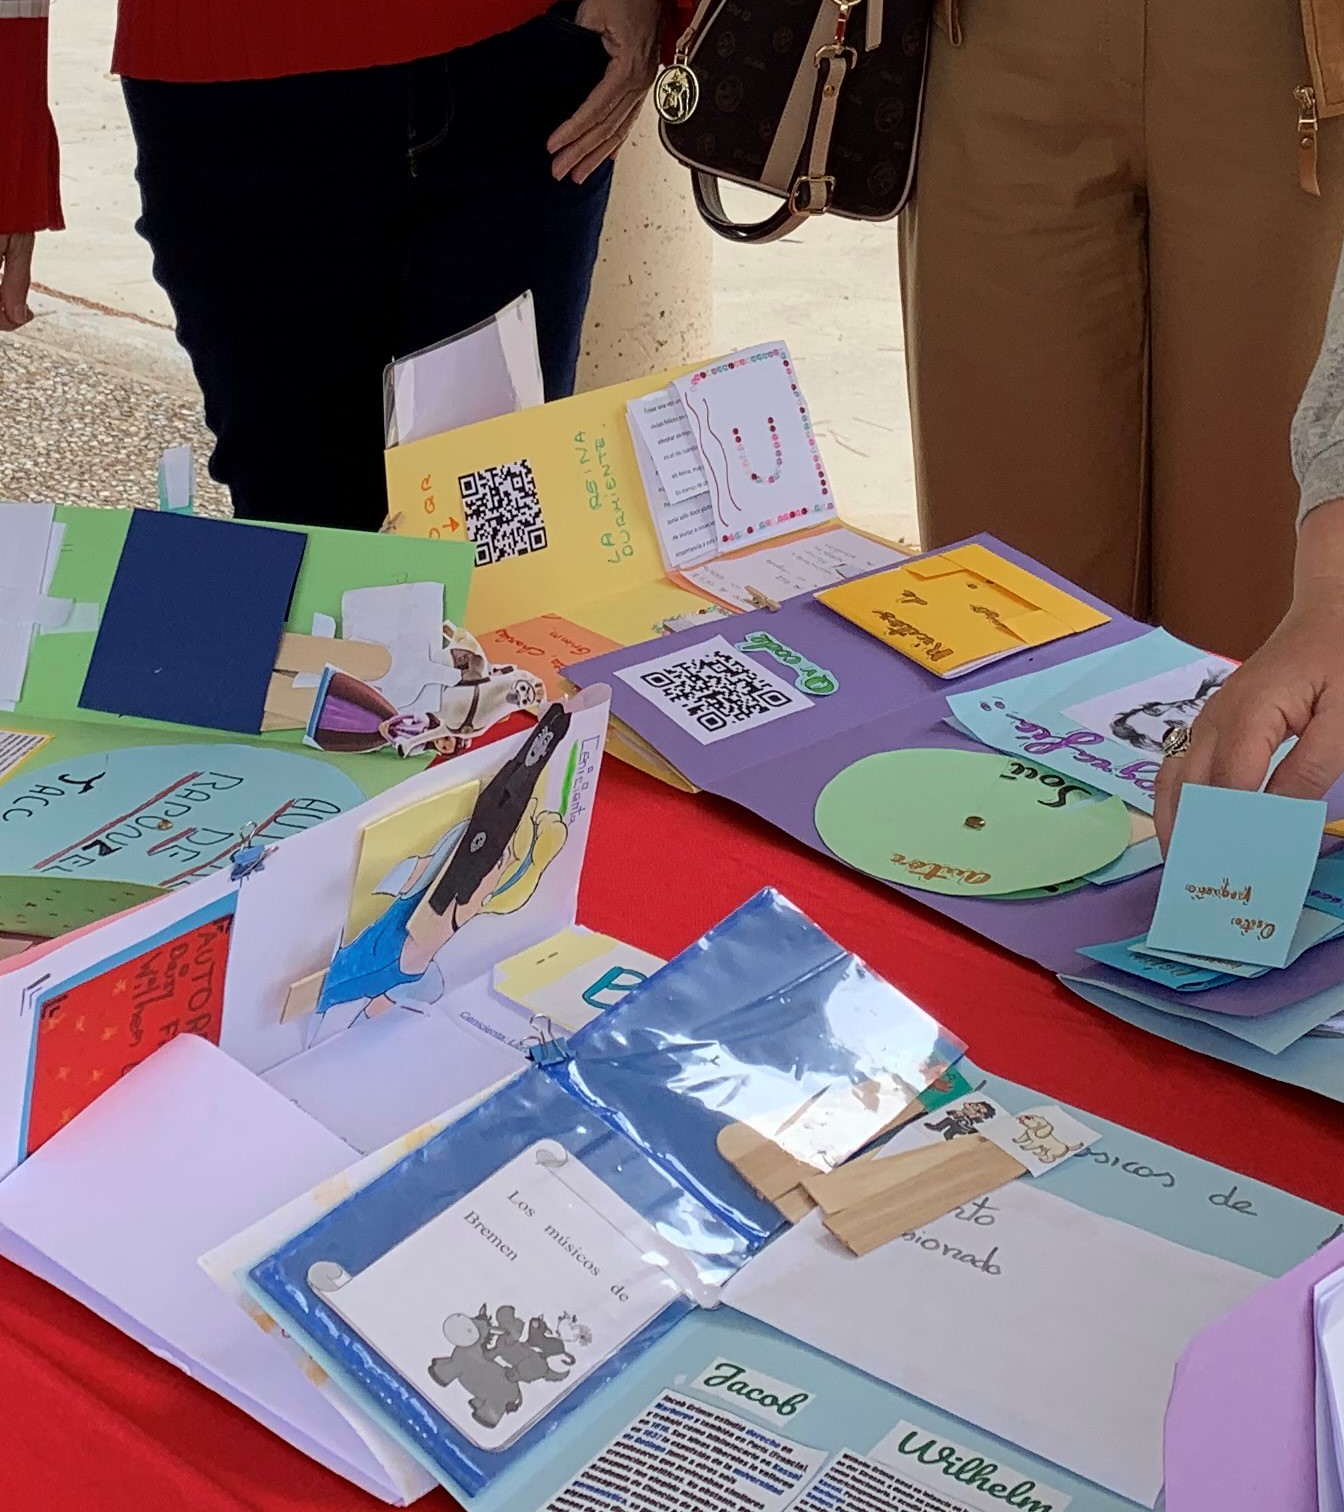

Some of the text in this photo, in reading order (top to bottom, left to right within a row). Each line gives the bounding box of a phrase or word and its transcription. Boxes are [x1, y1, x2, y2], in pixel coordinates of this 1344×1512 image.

[600, 532, 622, 565] LA
[165, 826, 236, 865] DE
[1207, 1185, 1259, 1218] de
[463, 1210, 520, 1263] Bremen
[507, 1188, 631, 1305] Los músicos de
[703, 1362, 810, 1417] Jacob
[897, 1429, 1058, 1512] Wilhelm
